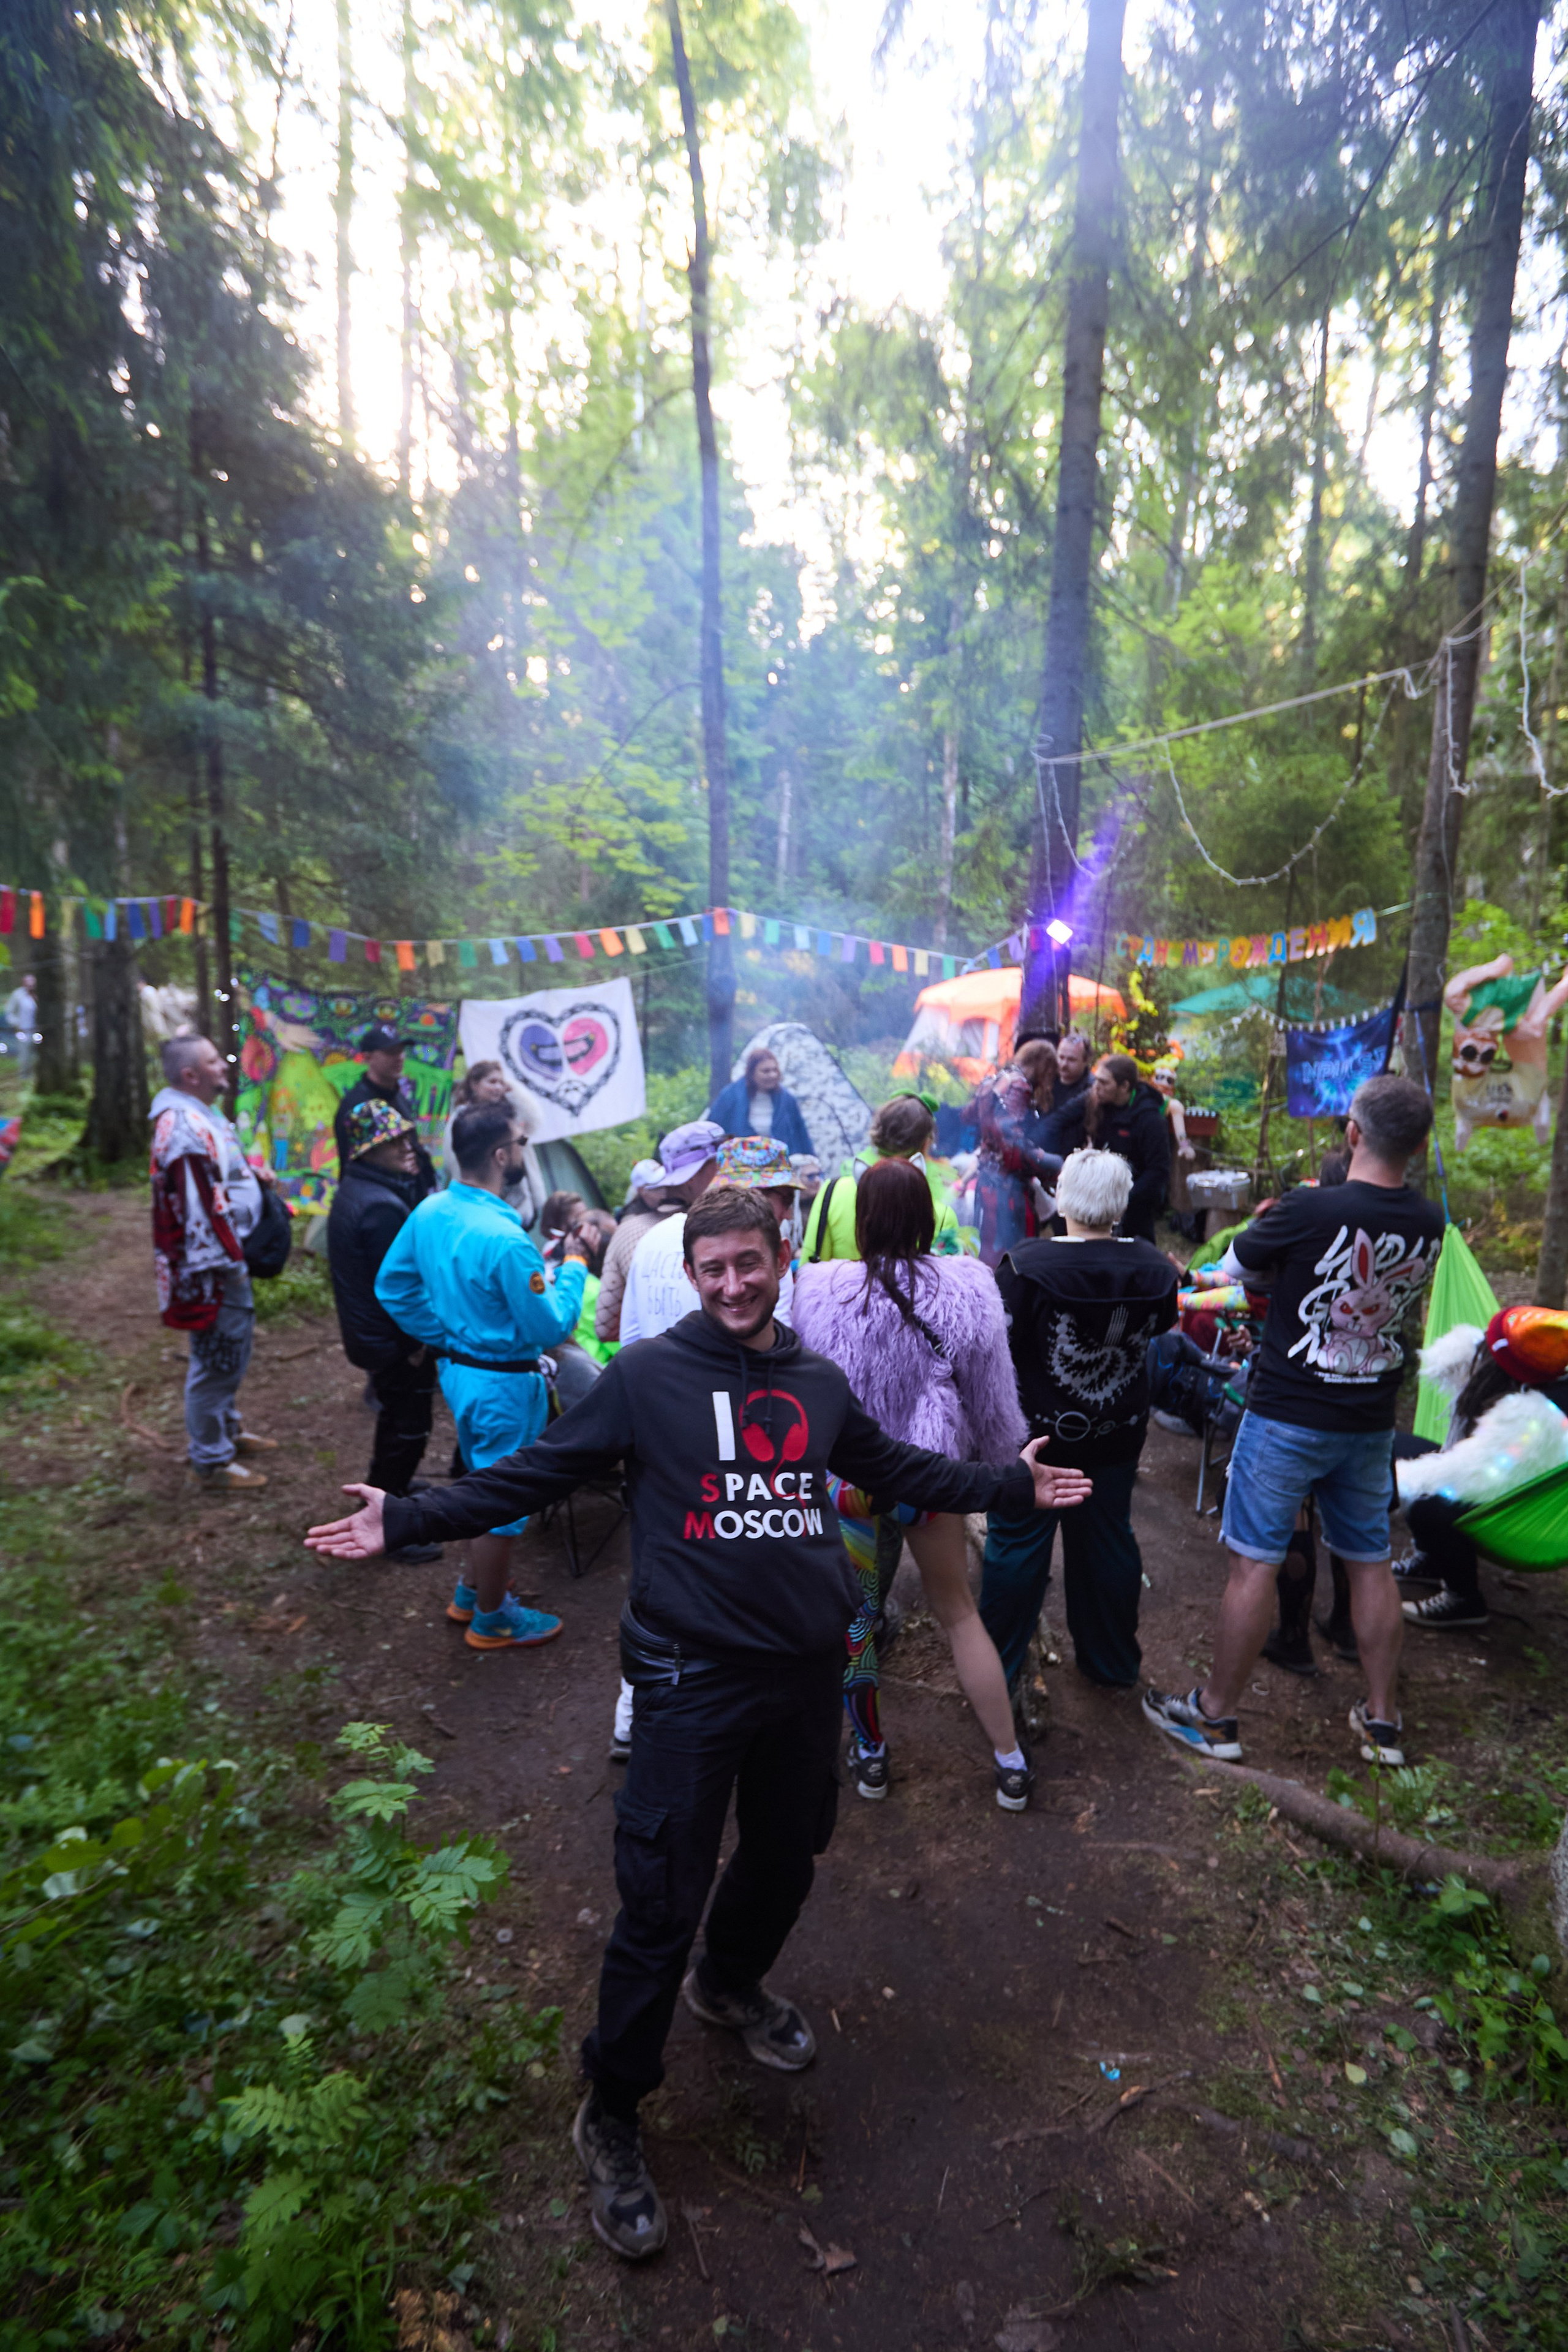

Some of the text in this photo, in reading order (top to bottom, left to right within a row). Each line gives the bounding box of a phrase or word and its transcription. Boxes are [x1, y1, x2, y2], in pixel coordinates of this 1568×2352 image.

[1217, 907, 1377, 968] РОЖДЕНИЯ
[712, 1391, 736, 1461] I
[700, 1472, 813, 1502] SPACE
[684, 1508, 824, 1539] MOSCOW
